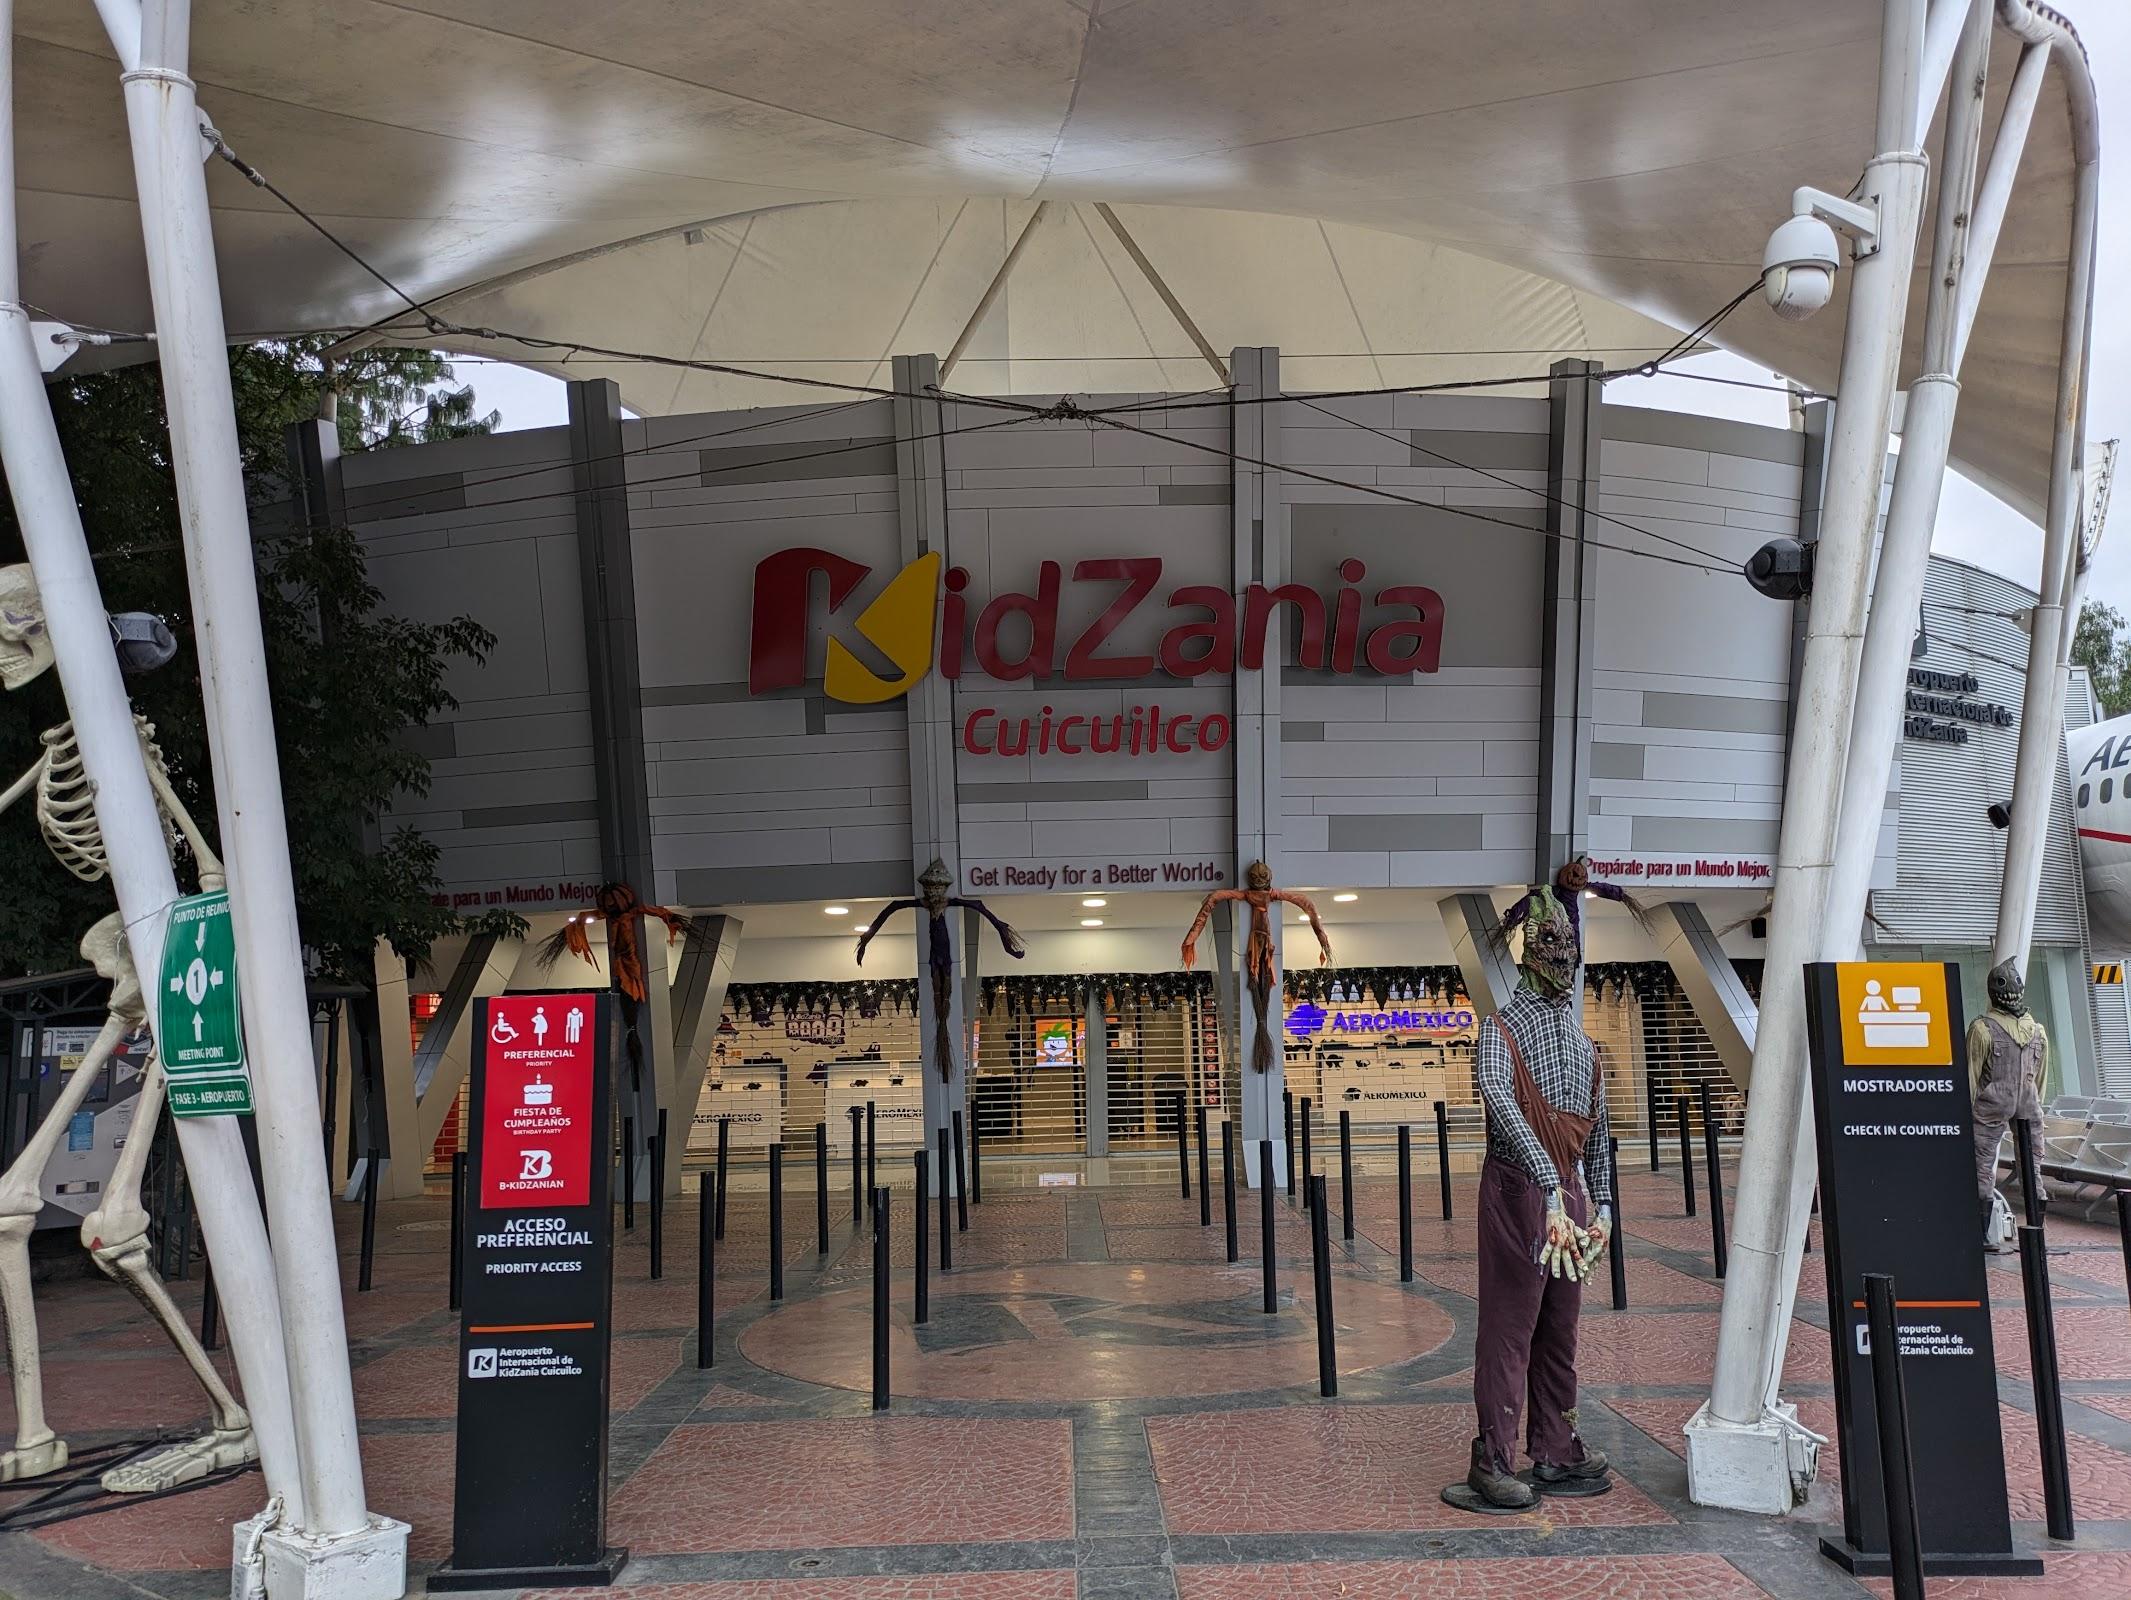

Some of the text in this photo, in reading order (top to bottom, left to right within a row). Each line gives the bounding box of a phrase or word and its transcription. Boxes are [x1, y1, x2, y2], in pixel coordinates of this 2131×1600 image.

[749, 546, 1446, 704] KidZania
[1907, 668, 1979, 693] eropuerto
[962, 705, 1231, 757] Cuicuilco
[1904, 715, 1968, 743] idZania
[1646, 862, 1673, 879] para
[1677, 863, 1692, 876] un
[1695, 859, 1734, 877] Mundo
[971, 867, 1000, 887] Get
[1005, 866, 1058, 889] Ready
[1063, 865, 1087, 885] for
[1092, 868, 1102, 883] a
[1108, 864, 1157, 884] Better
[452, 891, 482, 910] para
[485, 890, 502, 904] un
[505, 884, 555, 904] Mundo
[173, 908, 196, 925] PUNTO
[195, 905, 206, 920] DE
[193, 969, 199, 994] 1
[178, 1047, 225, 1061] MEETING POINT
[503, 1049, 575, 1060] PREFERENCIAL
[525, 1060, 553, 1068] PRIORITY
[1843, 1079, 1954, 1093] MOSTRADORES
[175, 1092, 192, 1105] FASE
[191, 1092, 197, 1104] 3
[200, 1090, 246, 1104] AEROPUERTO
[513, 1106, 562, 1117] FIESTA DE
[504, 1116, 571, 1128] CUMPLEAÑOS
[1843, 1125, 1961, 1136] CHECK IN COUNTERS
[504, 1218, 567, 1233] ACCESO
[477, 1232, 593, 1248] PREFERENCIAL
[485, 1261, 582, 1274] PRIORITY ACCESS
[1897, 1324, 1941, 1335] ropuerto
[1899, 1334, 1964, 1345] ernacional de
[499, 1347, 553, 1358] Aeropuerto
[1899, 1345, 1974, 1355] dZania Cuicuilco
[500, 1355, 574, 1367] Internacional de
[499, 1365, 583, 1377] KidZania Cuicuilco
